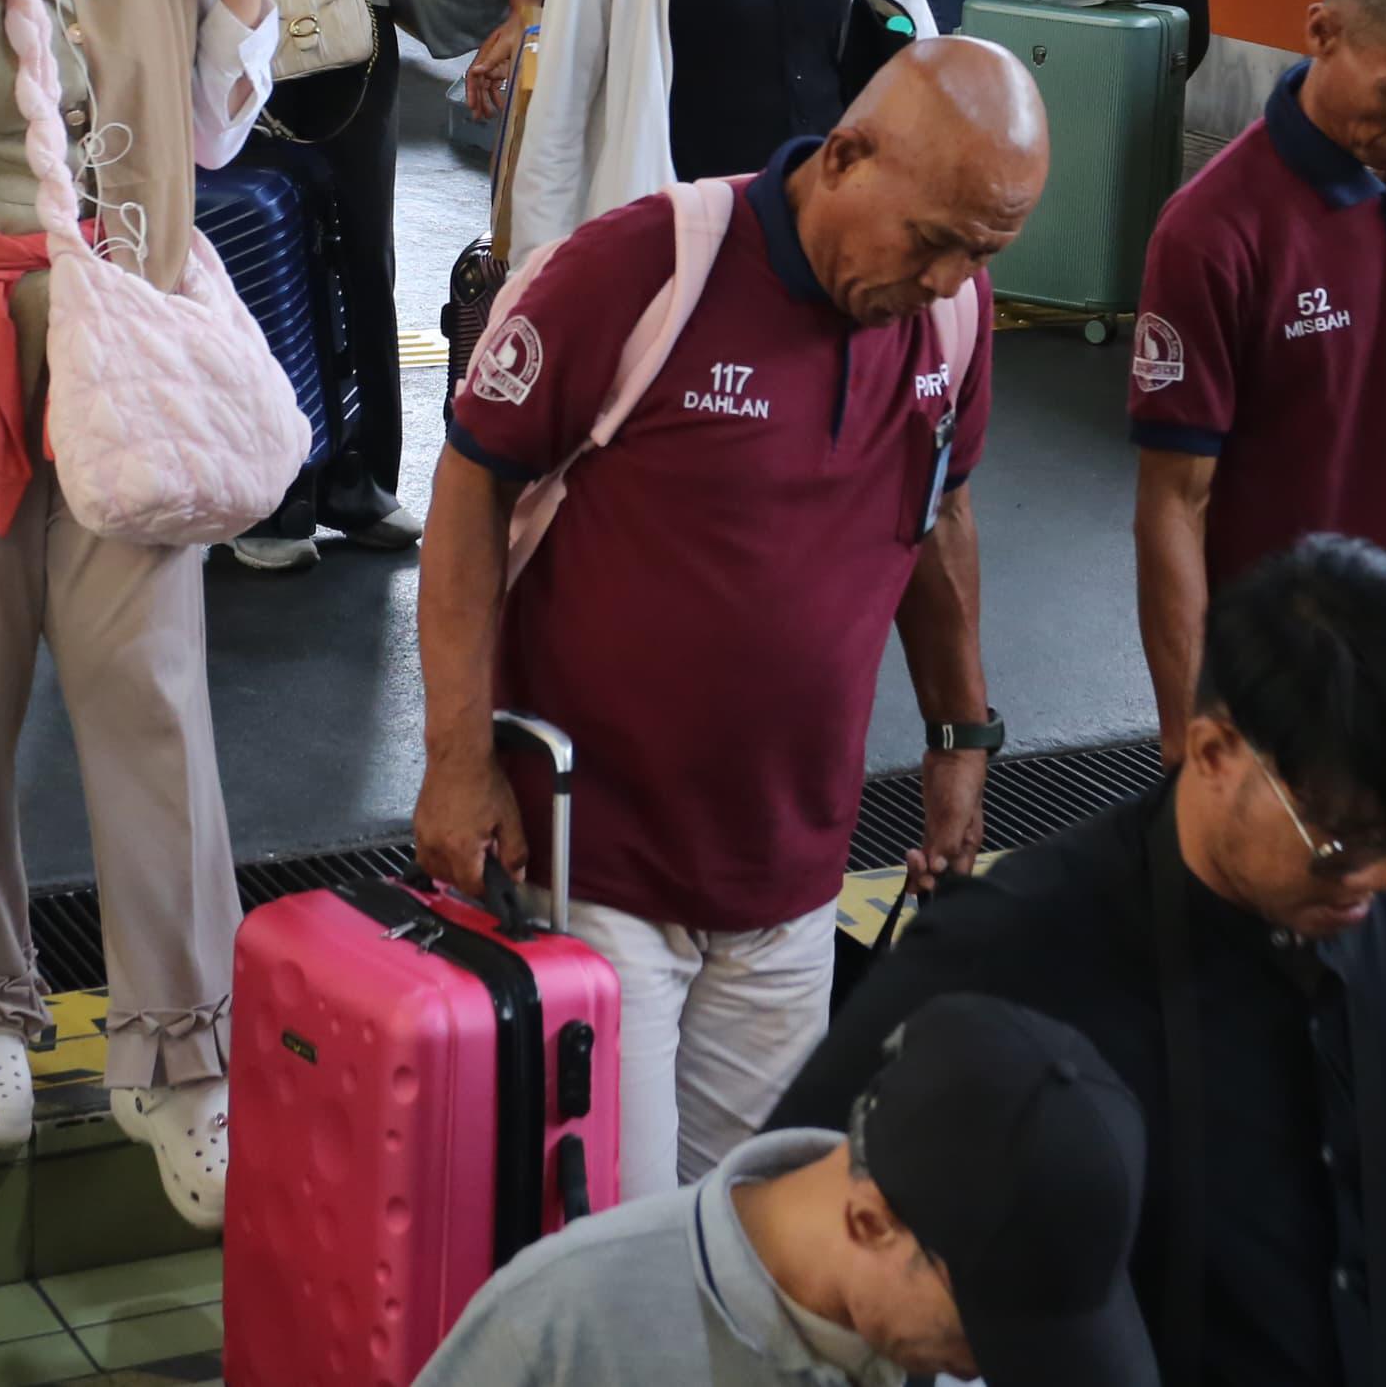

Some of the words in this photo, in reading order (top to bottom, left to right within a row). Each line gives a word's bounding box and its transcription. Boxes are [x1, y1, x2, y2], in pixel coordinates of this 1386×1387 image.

[1297, 287, 1331, 316] 52
[1285, 309, 1351, 341] MISBAH
[711, 362, 753, 395] 117
[683, 390, 770, 419] DAHLAN
